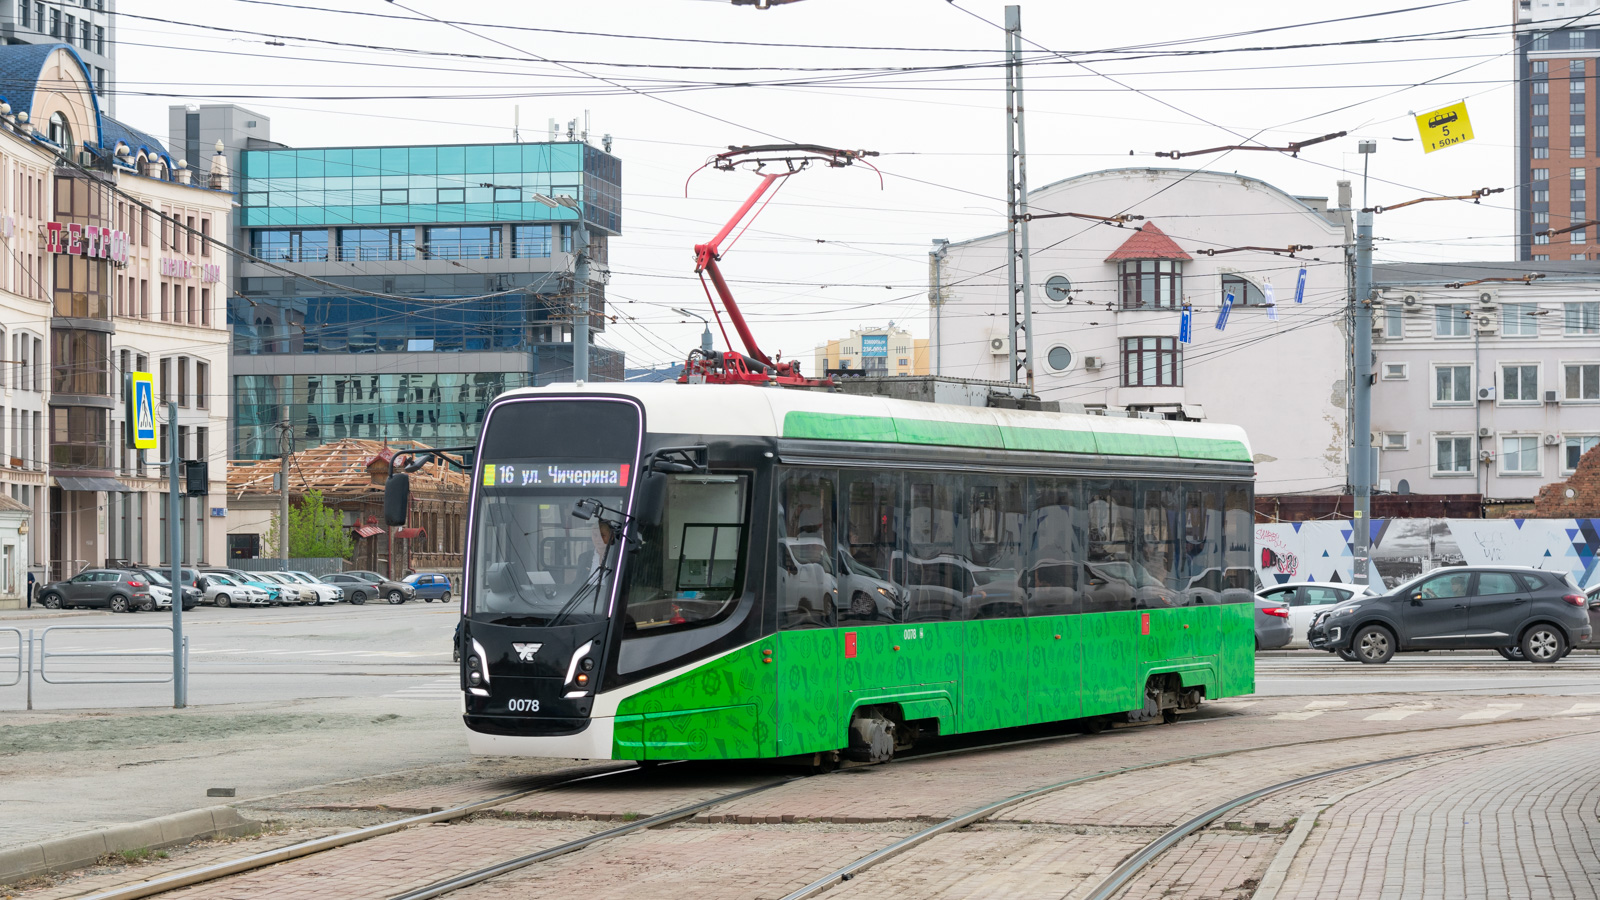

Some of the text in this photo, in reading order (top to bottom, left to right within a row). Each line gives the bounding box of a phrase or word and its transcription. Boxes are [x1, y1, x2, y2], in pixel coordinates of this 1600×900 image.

[1442, 126, 1450, 137] 5
[161, 257, 220, 283] БИЗНЕС ДОМ
[499, 465, 618, 486] 16 ул. Чичерина
[903, 628, 917, 641] 0078
[508, 698, 540, 712] 0078
